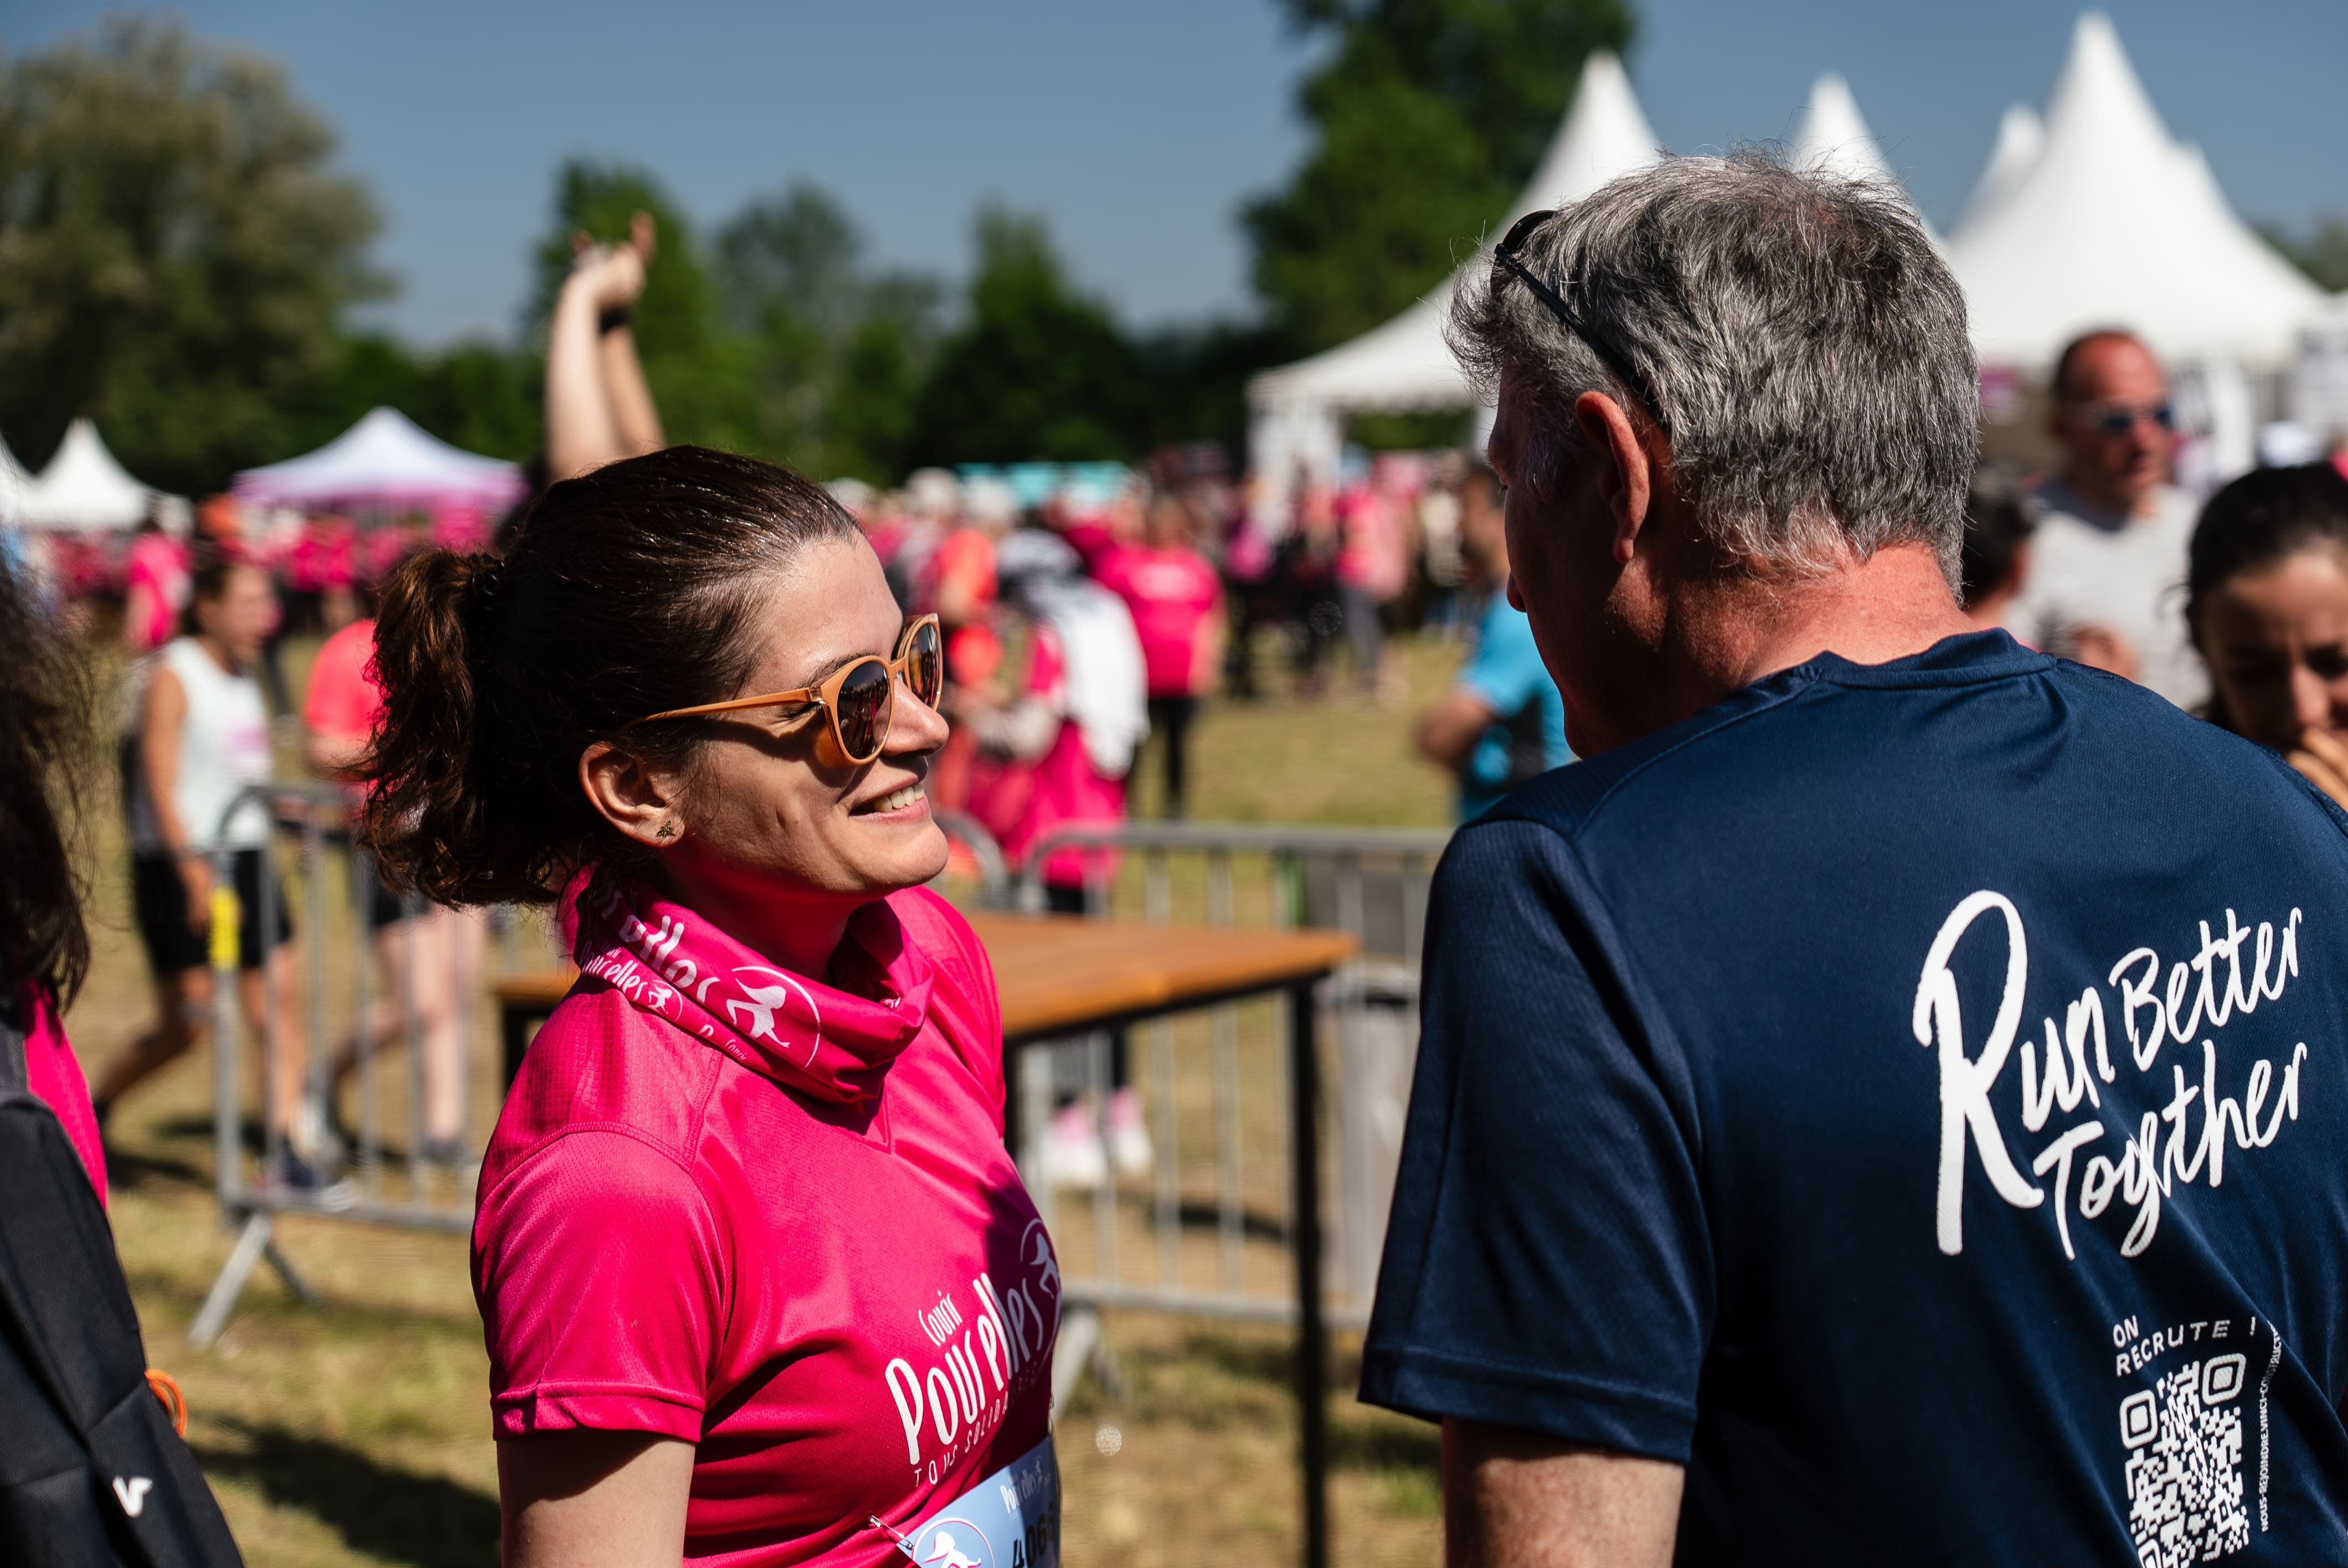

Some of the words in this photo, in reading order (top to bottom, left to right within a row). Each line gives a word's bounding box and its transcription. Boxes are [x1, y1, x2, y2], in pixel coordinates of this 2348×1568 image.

[1913, 889, 2115, 1256] Run
[2108, 907, 2302, 1071] Better
[2032, 1039, 2308, 1260] Togther
[918, 1290, 962, 1347] Courir
[2113, 1314, 2140, 1348] ON
[2116, 1319, 2231, 1378] RECRUTE
[914, 1444, 958, 1488] TOUS
